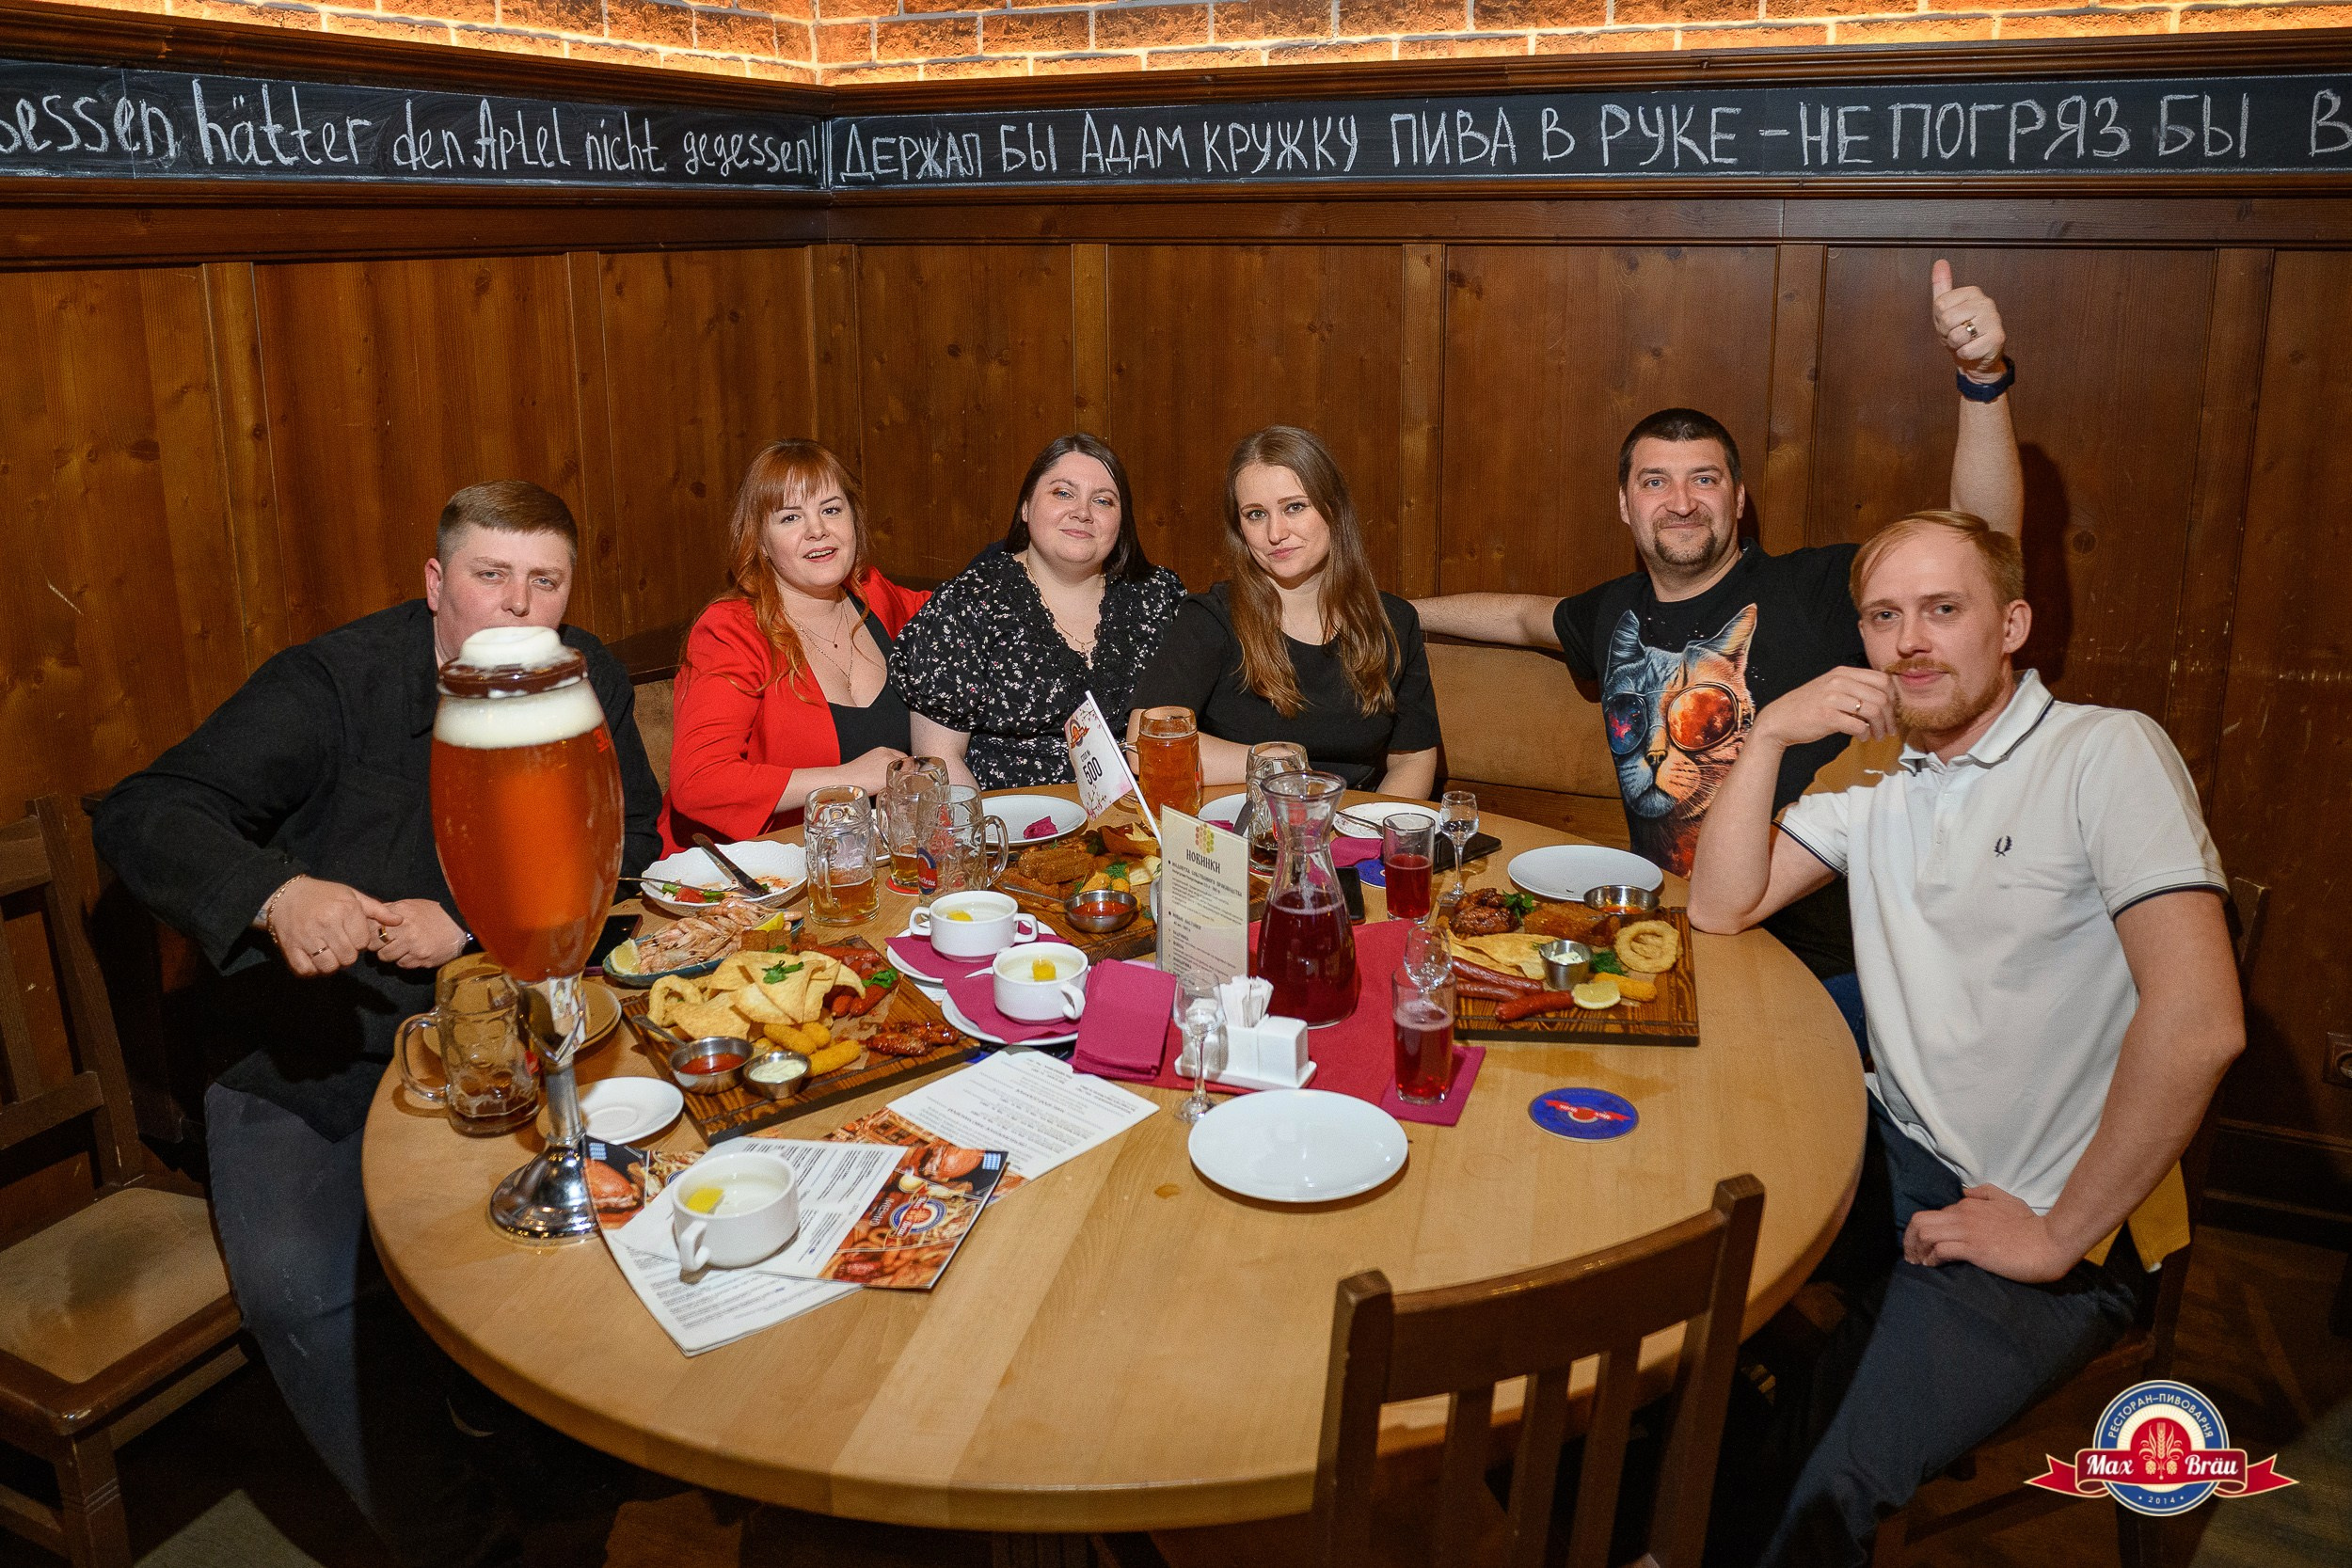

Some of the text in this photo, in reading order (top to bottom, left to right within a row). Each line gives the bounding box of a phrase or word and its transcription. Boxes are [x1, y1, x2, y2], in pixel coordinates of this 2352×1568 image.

[393, 98, 466, 171] den
[585, 111, 666, 171] nicht
[1000, 122, 1057, 173] БЫ
[1081, 112, 1189, 174] АДАМ
[1203, 114, 1358, 174] КРУЖКУ
[1391, 106, 1517, 166] ПИВА
[1540, 107, 1577, 162] В
[1600, 103, 1743, 168] РУКЕ
[1892, 94, 2132, 164] ПОГРЯЗ
[2158, 92, 2249, 158] БЫ
[1082, 756, 1103, 785] 500
[1185, 848, 1221, 875] НОВИНКИ
